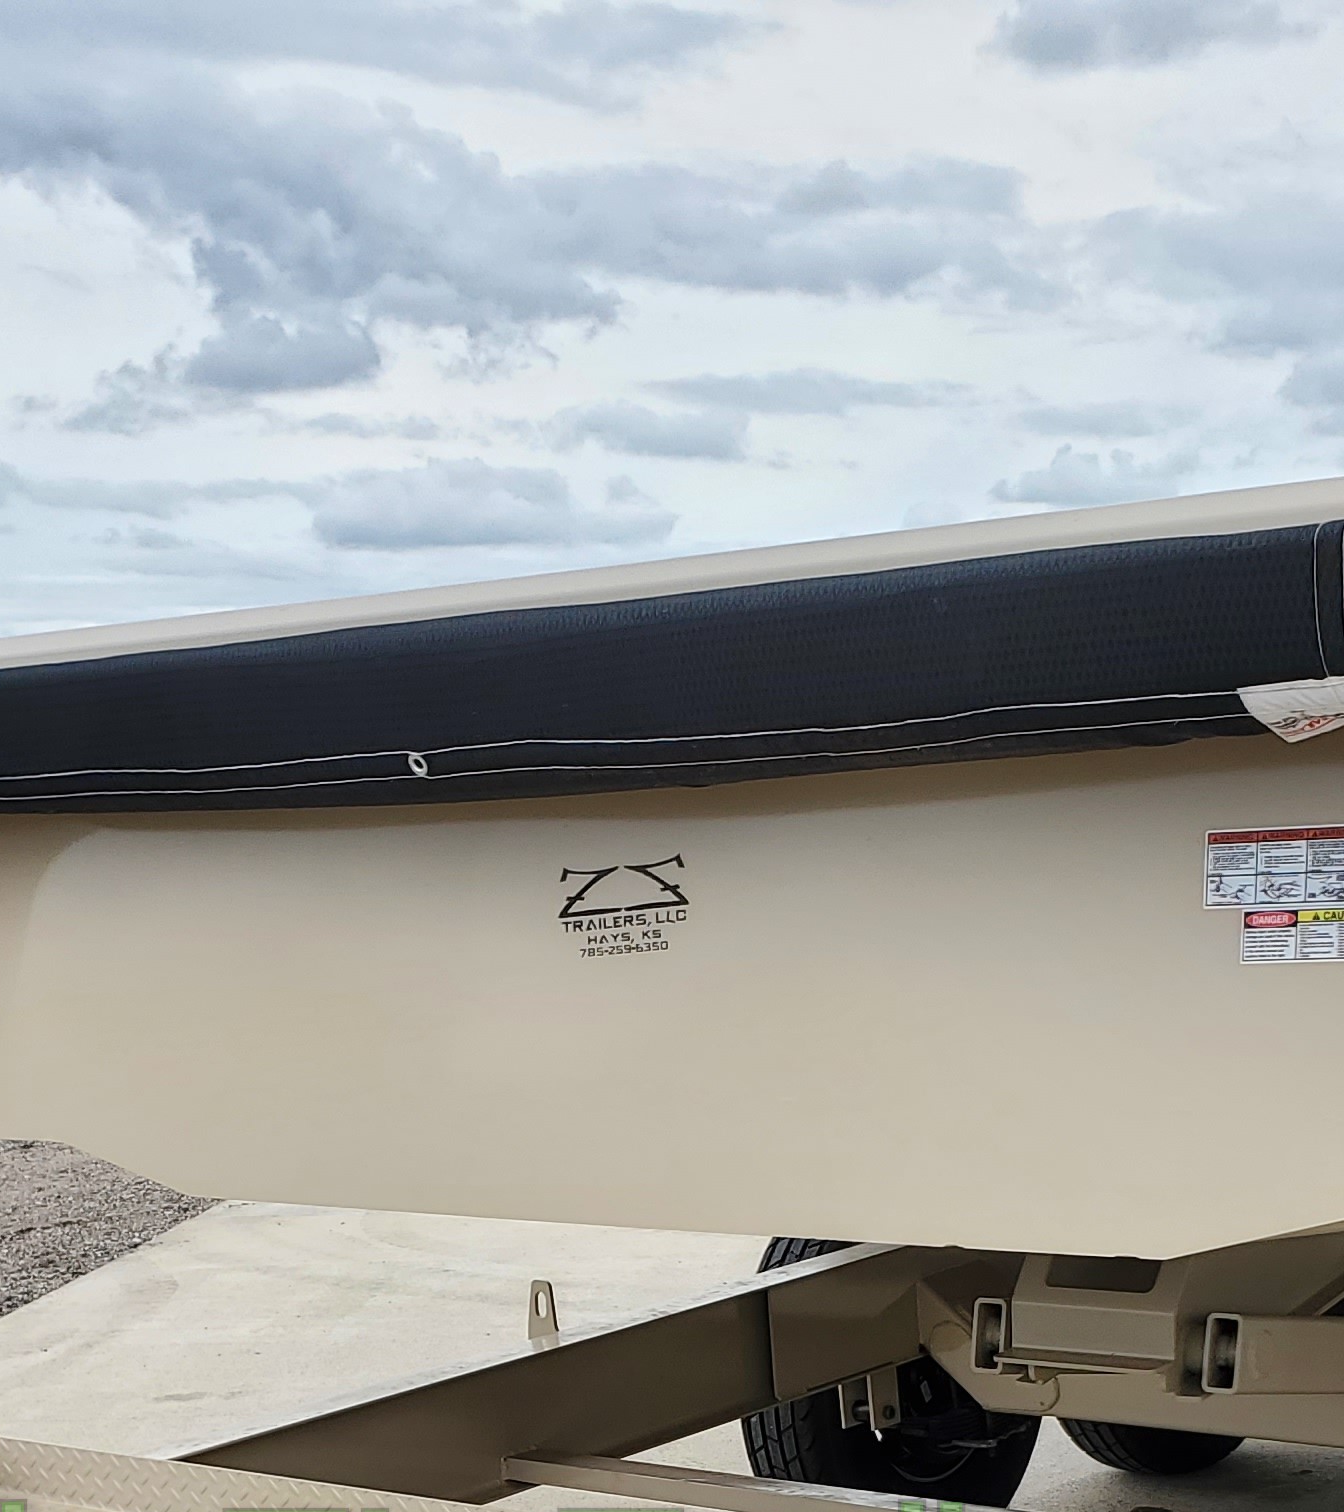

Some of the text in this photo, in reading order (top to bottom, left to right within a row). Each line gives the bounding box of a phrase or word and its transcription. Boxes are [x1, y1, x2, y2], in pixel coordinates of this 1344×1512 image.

[562, 909, 687, 933] TRAILERS, LLC
[1252, 914, 1289, 925] DANGER
[587, 929, 662, 945] HAYS, KS
[579, 941, 669, 958] 785-259-6350
